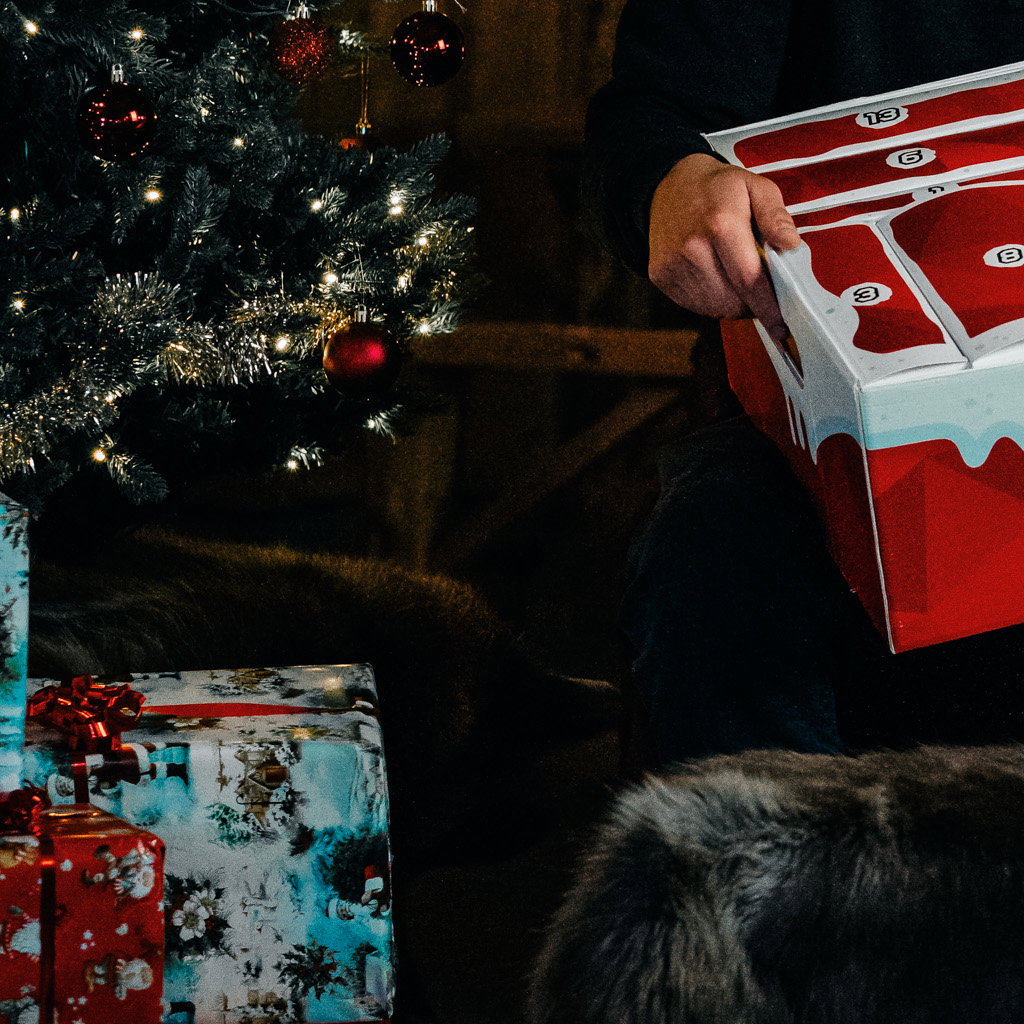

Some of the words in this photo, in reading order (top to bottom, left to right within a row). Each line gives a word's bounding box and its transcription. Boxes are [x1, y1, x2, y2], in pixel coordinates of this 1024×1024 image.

[863, 108, 900, 125] 13
[898, 150, 923, 166] 6
[997, 248, 1023, 264] 8
[853, 286, 879, 303] 3
